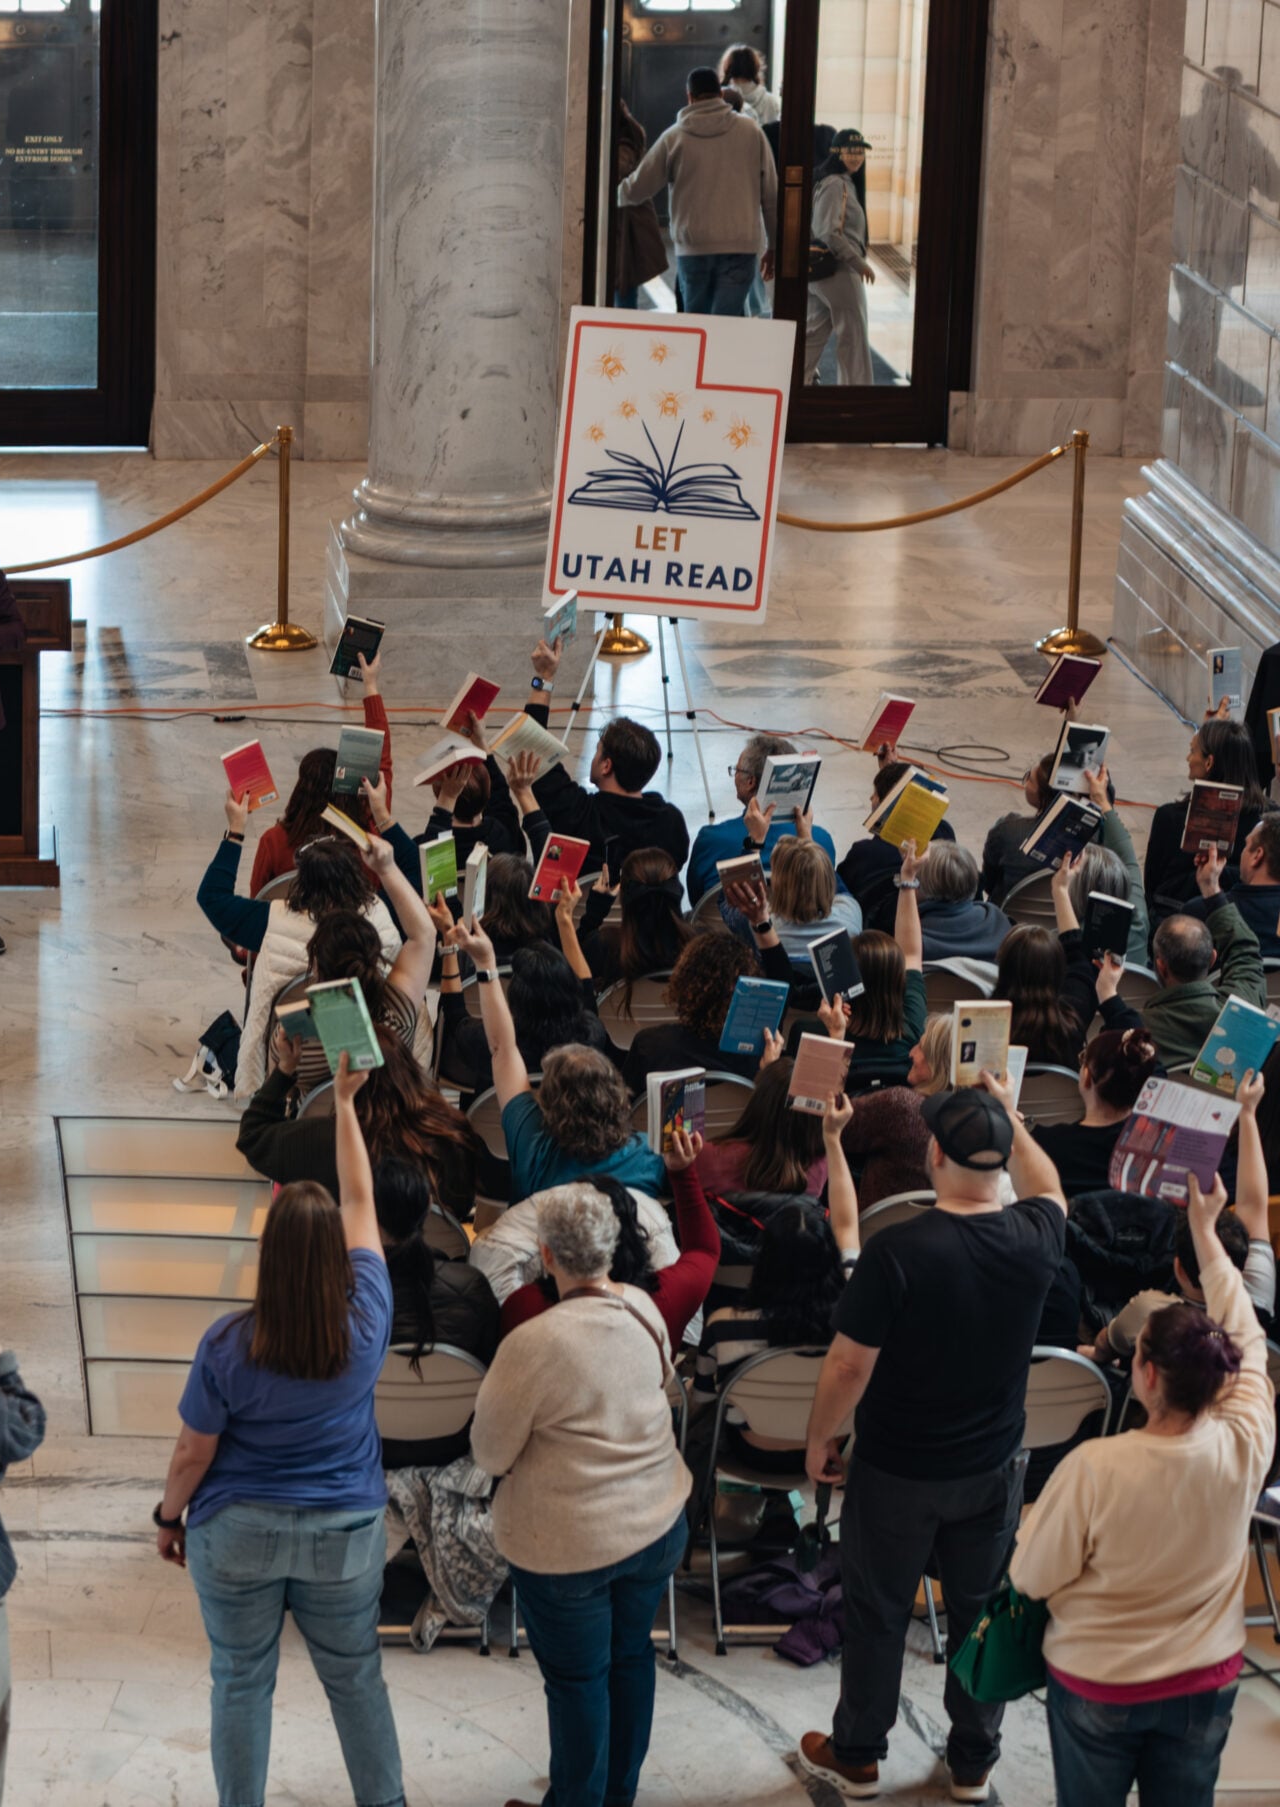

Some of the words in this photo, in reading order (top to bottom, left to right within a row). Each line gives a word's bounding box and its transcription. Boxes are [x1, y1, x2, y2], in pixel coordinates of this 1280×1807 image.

[634, 525, 687, 552] LET
[562, 553, 651, 584] UTAH
[665, 561, 753, 592] READ
